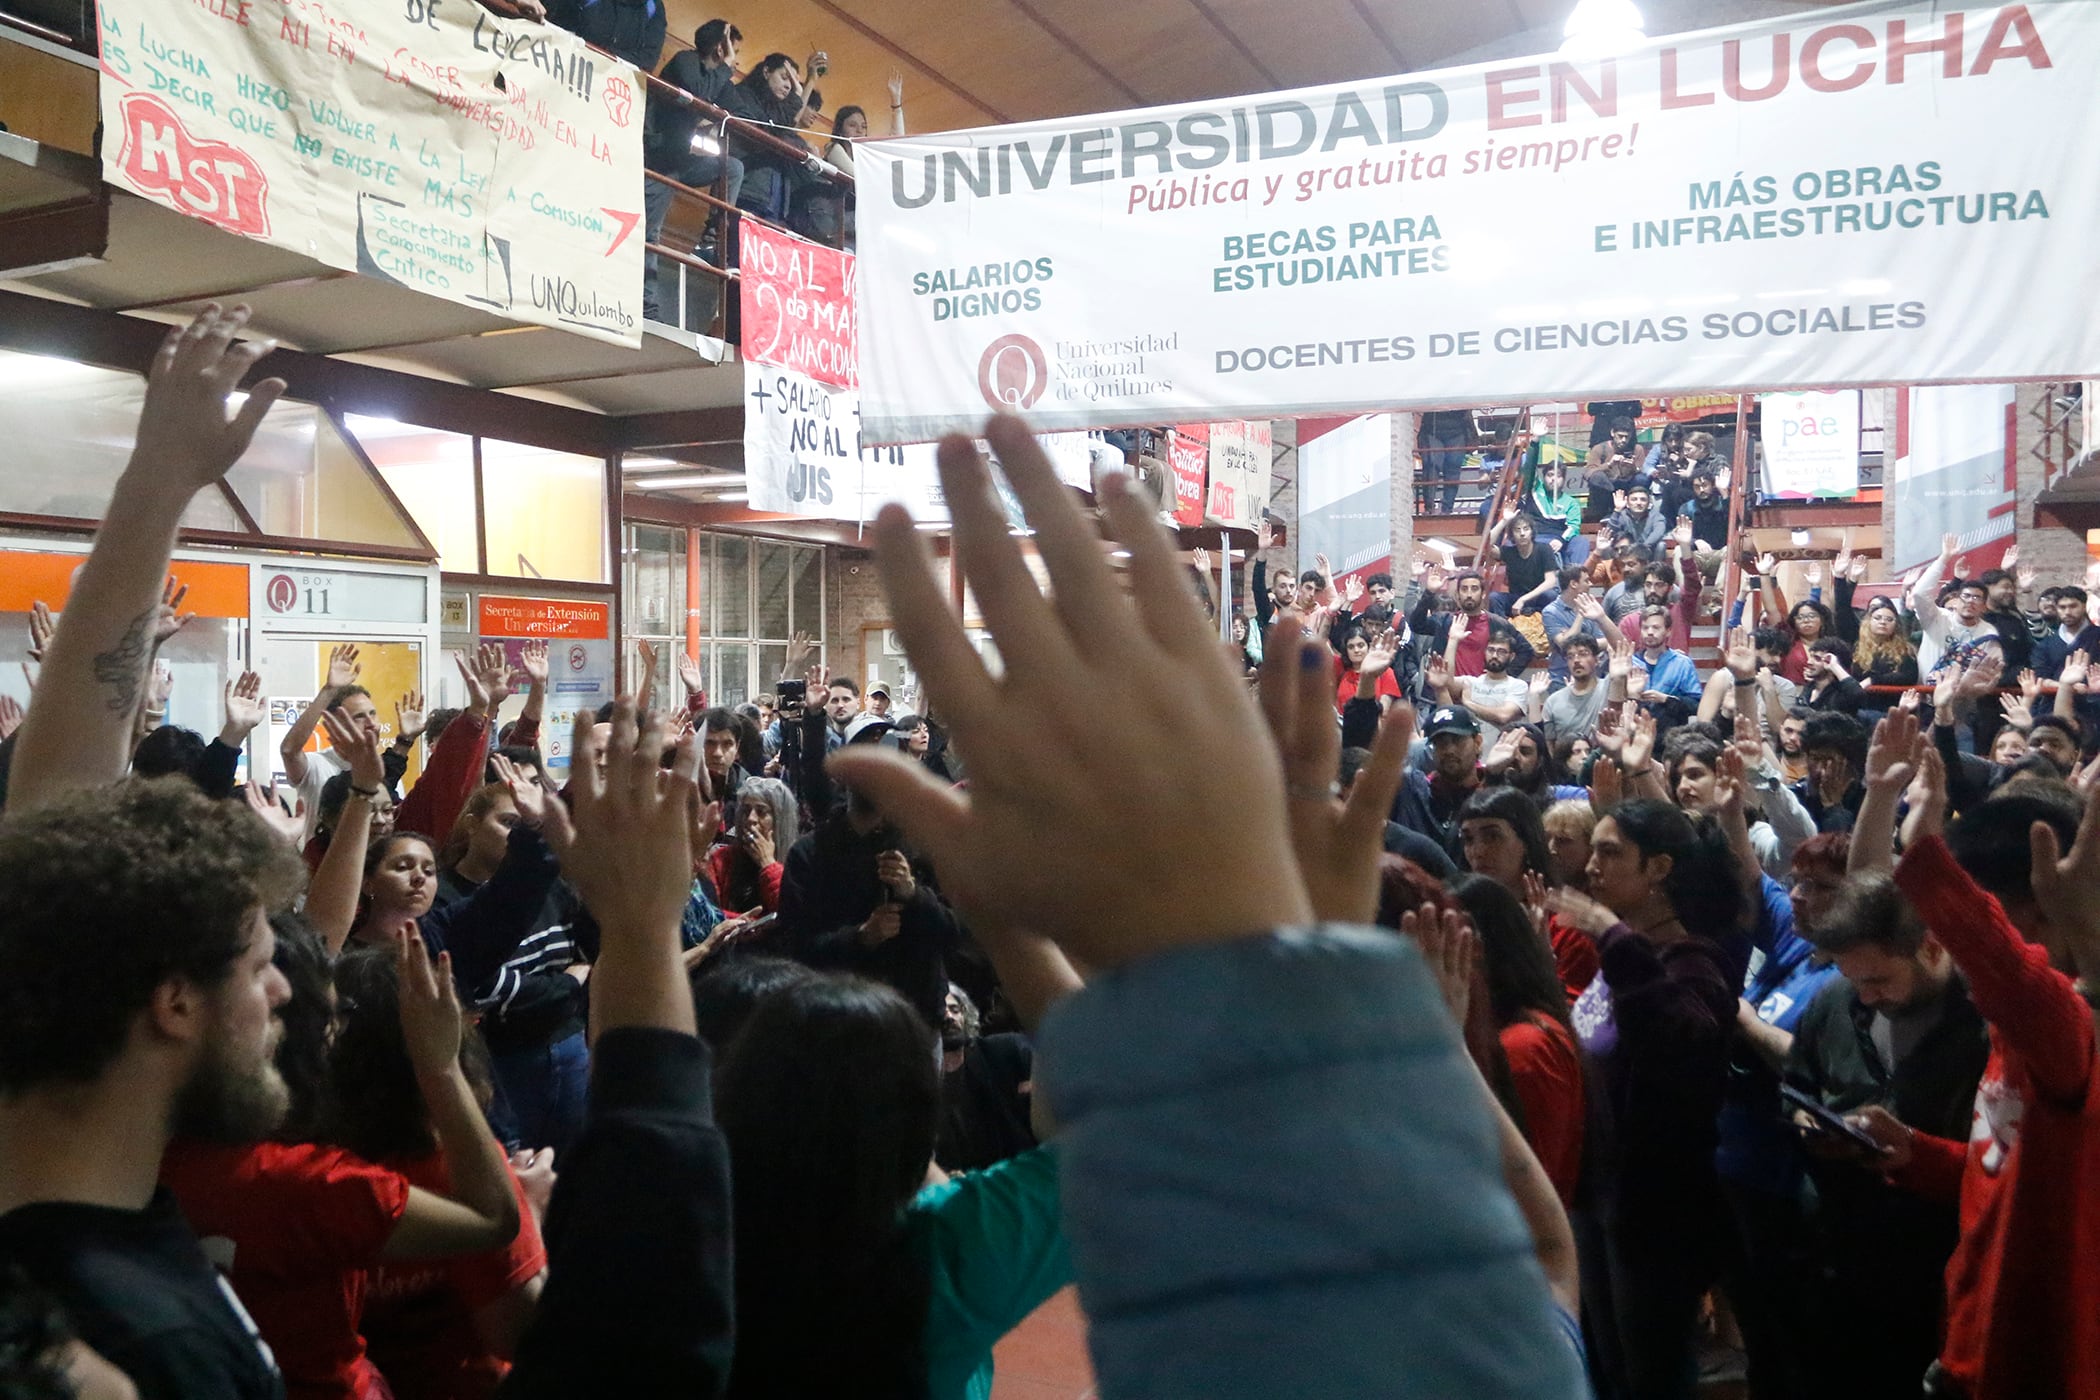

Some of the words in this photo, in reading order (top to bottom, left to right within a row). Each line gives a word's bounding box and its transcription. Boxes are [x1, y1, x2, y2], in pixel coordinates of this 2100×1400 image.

[280, 15, 309, 49] NI
[140, 22, 211, 80] LUCHA
[389, 132, 401, 151] A
[891, 81, 1450, 210] UNIVERSIDAD
[1484, 60, 1618, 132] EN
[1659, 4, 2053, 111] LUCHA
[103, 41, 131, 75] ES
[144, 61, 216, 117] DECIR
[228, 108, 276, 140] QUE
[331, 147, 399, 186] EXISTE
[141, 119, 247, 221] MST
[591, 133, 612, 166] LA
[1127, 173, 1249, 215] Pública
[1263, 175, 1284, 206] y
[1296, 148, 1448, 203] gratuita
[1462, 123, 1639, 175] siempre!
[1688, 171, 1778, 210] MÁS
[1792, 161, 1942, 201] OBRAS
[1223, 224, 1337, 262] BECAS
[1348, 214, 1442, 252] PARA
[1594, 224, 1617, 253] E
[1632, 189, 2050, 250] INFRAESTRUCTURA
[742, 233, 778, 276] NO
[787, 248, 826, 294] AL
[912, 256, 1054, 297] SALARIOS
[1213, 245, 1454, 293] ESTUDIANTES
[932, 287, 1043, 322] DIGNOS
[1055, 331, 1180, 361] Universidad
[1214, 335, 1416, 375] DOCENTES
[1427, 330, 1481, 359] DE
[1493, 315, 1689, 355] CIENCIAS
[1702, 301, 1927, 341] SOCIALES
[1055, 356, 1146, 383] Nacional
[1056, 381, 1079, 402] de
[1083, 376, 1174, 402] Quilmes
[790, 418, 818, 455] NO
[823, 427, 847, 458] AL
[1781, 416, 1839, 447] pae
[302, 576, 332, 586] BOX
[303, 588, 332, 614] 11
[547, 606, 600, 621] Extensión
